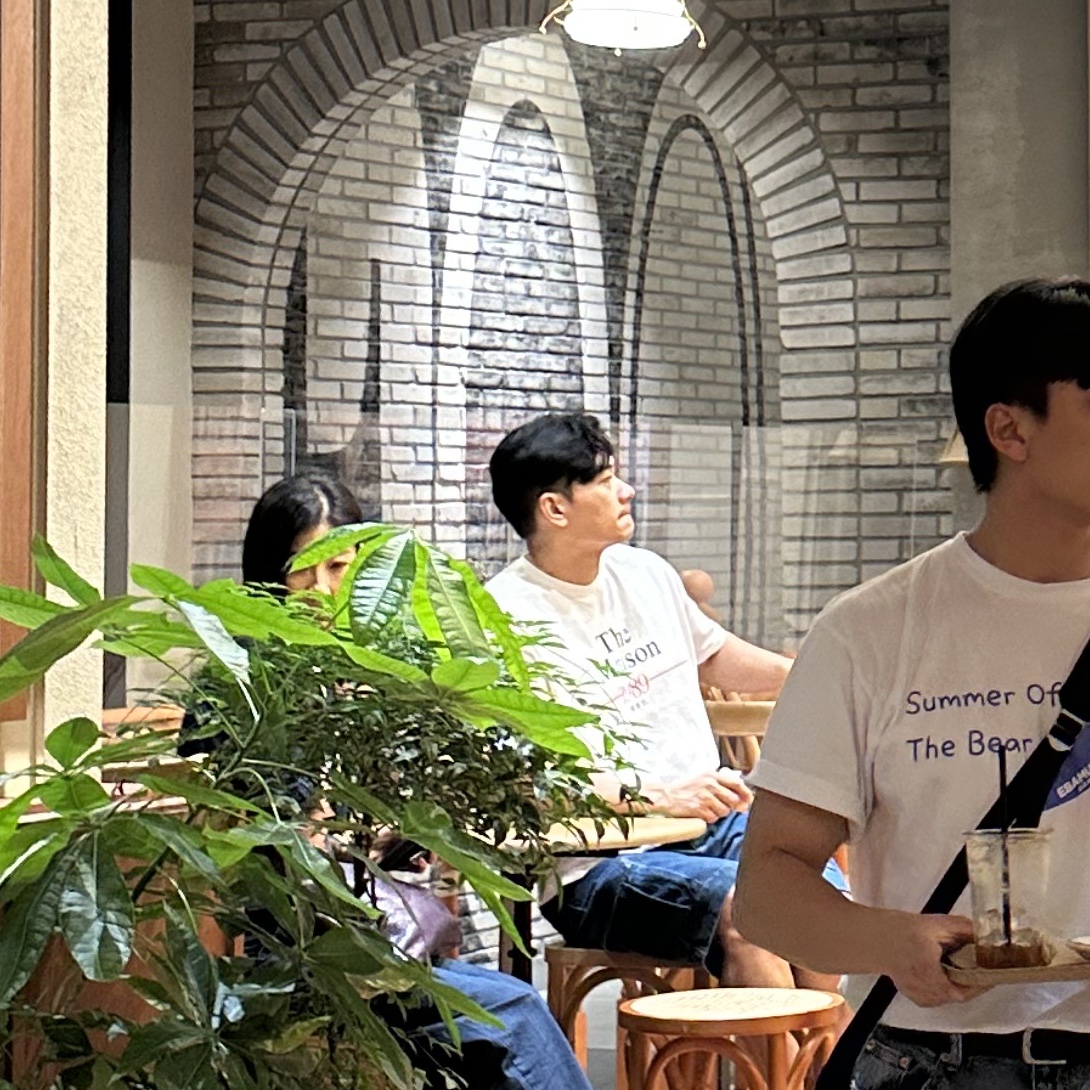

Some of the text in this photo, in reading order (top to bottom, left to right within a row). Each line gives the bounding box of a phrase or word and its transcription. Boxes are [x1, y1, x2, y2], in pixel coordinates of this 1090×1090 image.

[905, 681, 1063, 714] Summer Of
[906, 729, 1033, 763] The Bear
